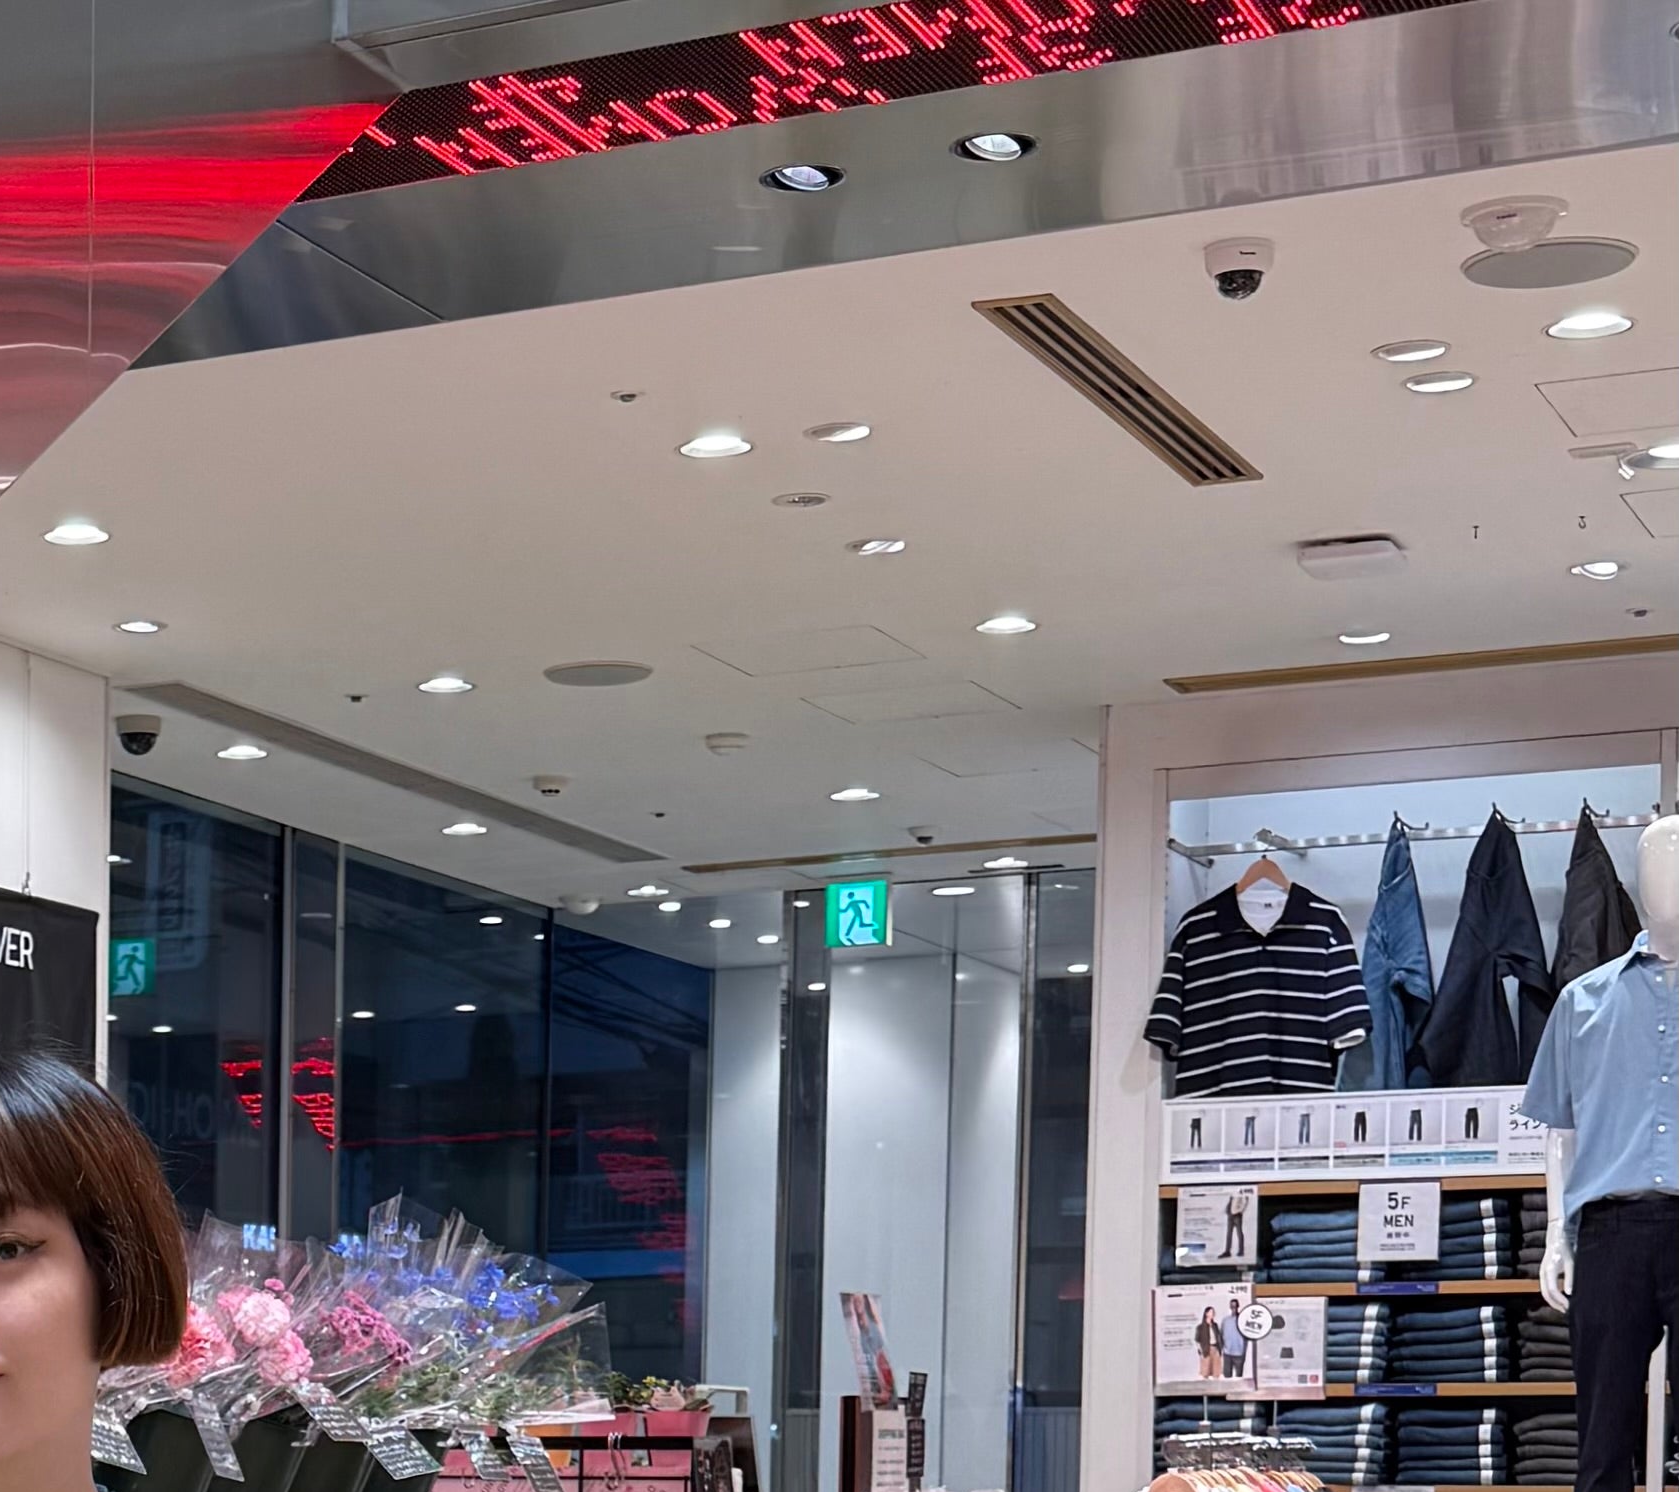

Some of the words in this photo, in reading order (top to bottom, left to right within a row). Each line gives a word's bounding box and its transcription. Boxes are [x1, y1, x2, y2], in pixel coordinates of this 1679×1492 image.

[1388, 1192, 1411, 1210] 5F
[1383, 1215, 1414, 1228] MEN
[243, 1223, 276, 1251] KA
